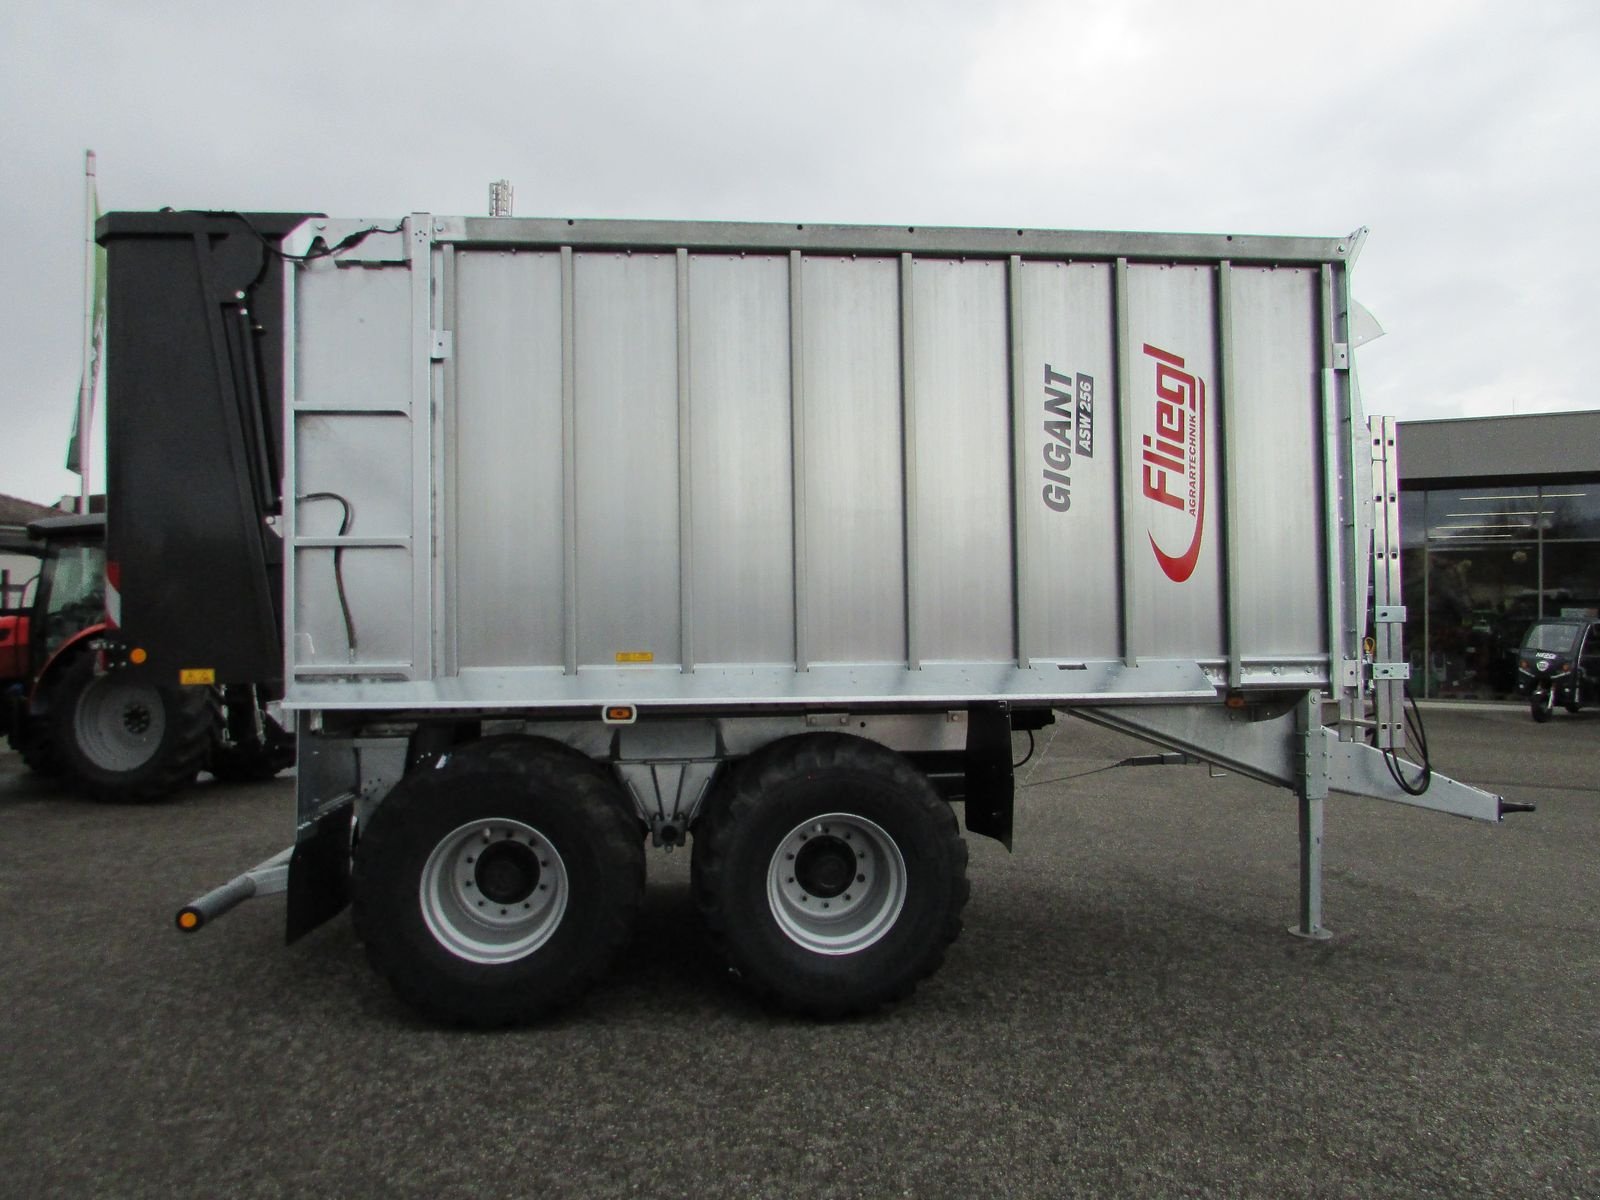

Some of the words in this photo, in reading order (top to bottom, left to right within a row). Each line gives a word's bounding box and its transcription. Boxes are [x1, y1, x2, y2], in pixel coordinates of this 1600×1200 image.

[1042, 363, 1072, 513] GIGANT
[1077, 412, 1092, 452] ASW
[1079, 380, 1092, 413] 256
[1143, 343, 1196, 511] Fliegl
[1188, 414, 1197, 517] AGRARTECHNIK
